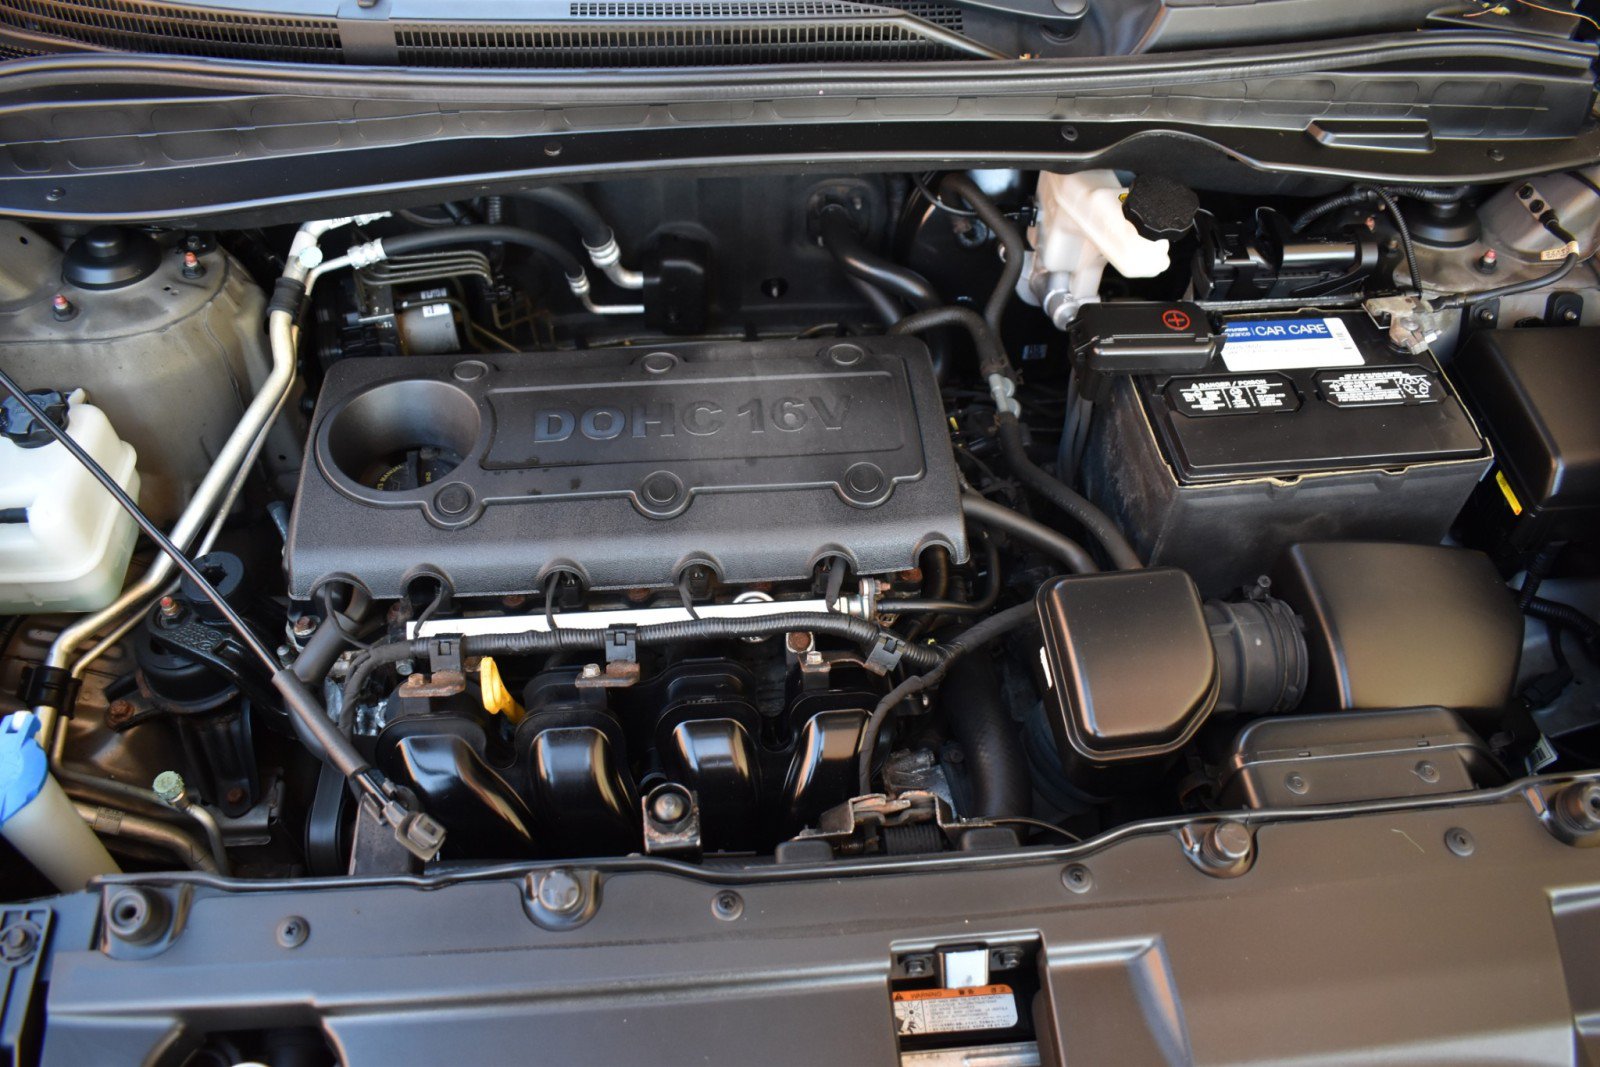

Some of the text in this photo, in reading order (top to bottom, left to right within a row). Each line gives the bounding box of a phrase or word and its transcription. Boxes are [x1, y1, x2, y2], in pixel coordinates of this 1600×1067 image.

[1255, 325, 1286, 337] CAR
[1289, 323, 1329, 335] CARE
[533, 395, 854, 443] DOHC 16V
[910, 991, 943, 999] WARNING
